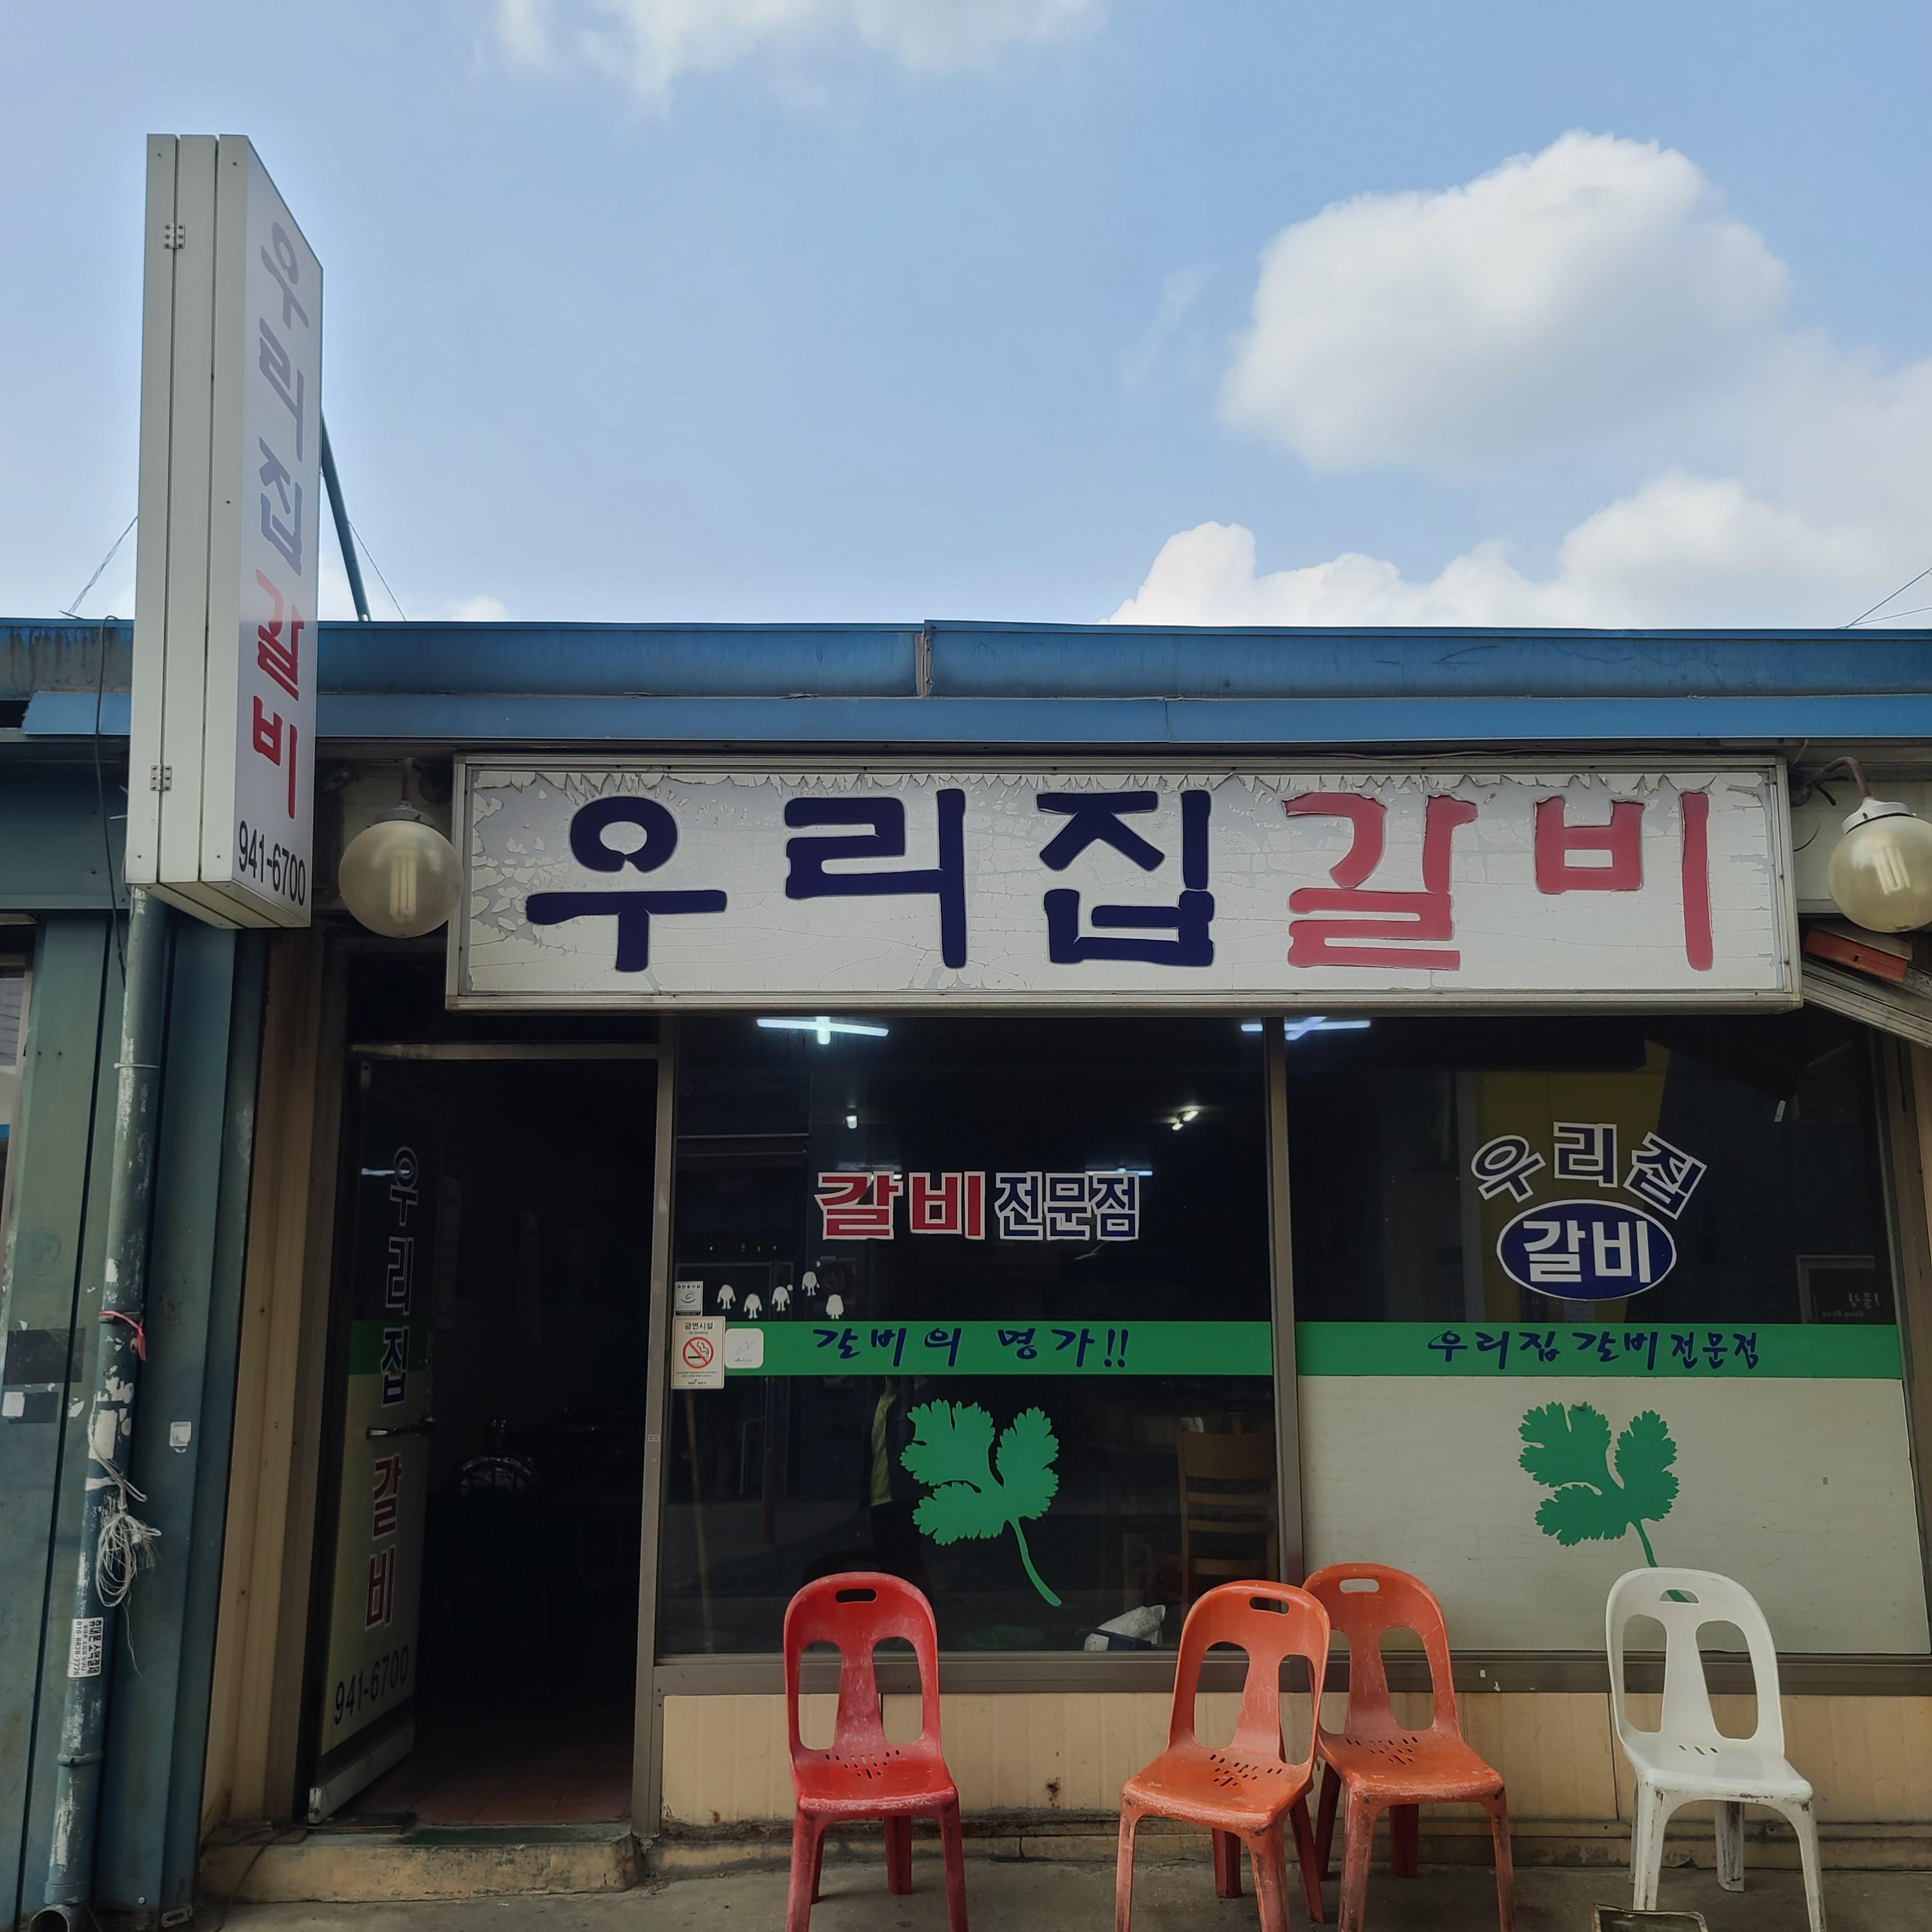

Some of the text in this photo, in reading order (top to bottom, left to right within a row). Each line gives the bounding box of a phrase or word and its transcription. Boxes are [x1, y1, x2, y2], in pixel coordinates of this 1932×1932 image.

[252, 221, 309, 820] 우리집 갈비
[238, 821, 307, 907] 941-6700
[526, 788, 1713, 972] 우리집 갈비
[814, 1171, 1140, 1240] 갈비 전문점
[1470, 1122, 1707, 1220] 우리집
[1523, 1220, 1652, 1283] 갈비
[684, 1322, 714, 1330] 금연시설
[812, 1328, 1129, 1368] 갈비의 명가!!
[1427, 1330, 1760, 1370] 우리집 갈비 전문점
[364, 1146, 418, 1632] 우리집 갈비
[87, 1619, 102, 1674] 휴대폰 소액결제
[334, 1643, 409, 1725] 941-6700
